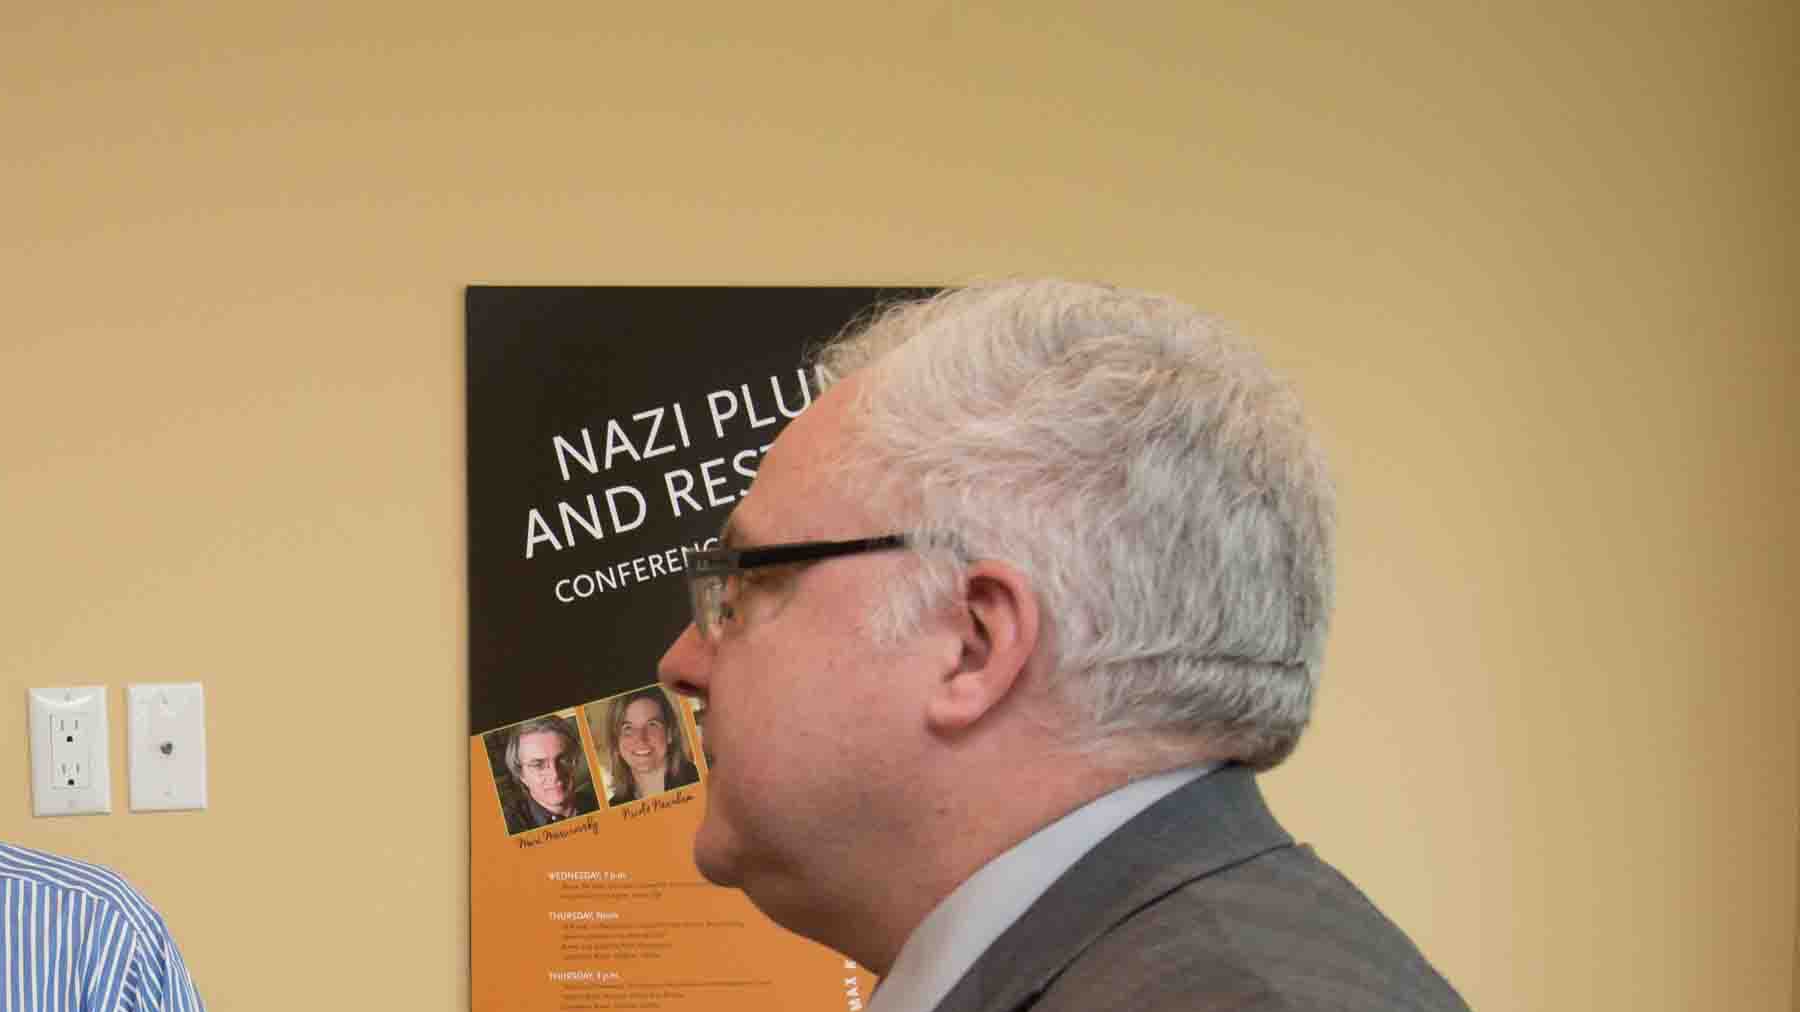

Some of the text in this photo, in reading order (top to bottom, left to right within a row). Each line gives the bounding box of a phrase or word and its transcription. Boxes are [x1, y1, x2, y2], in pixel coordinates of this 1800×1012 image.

[552, 402, 690, 481] NAZI
[523, 443, 776, 559] AND RES
